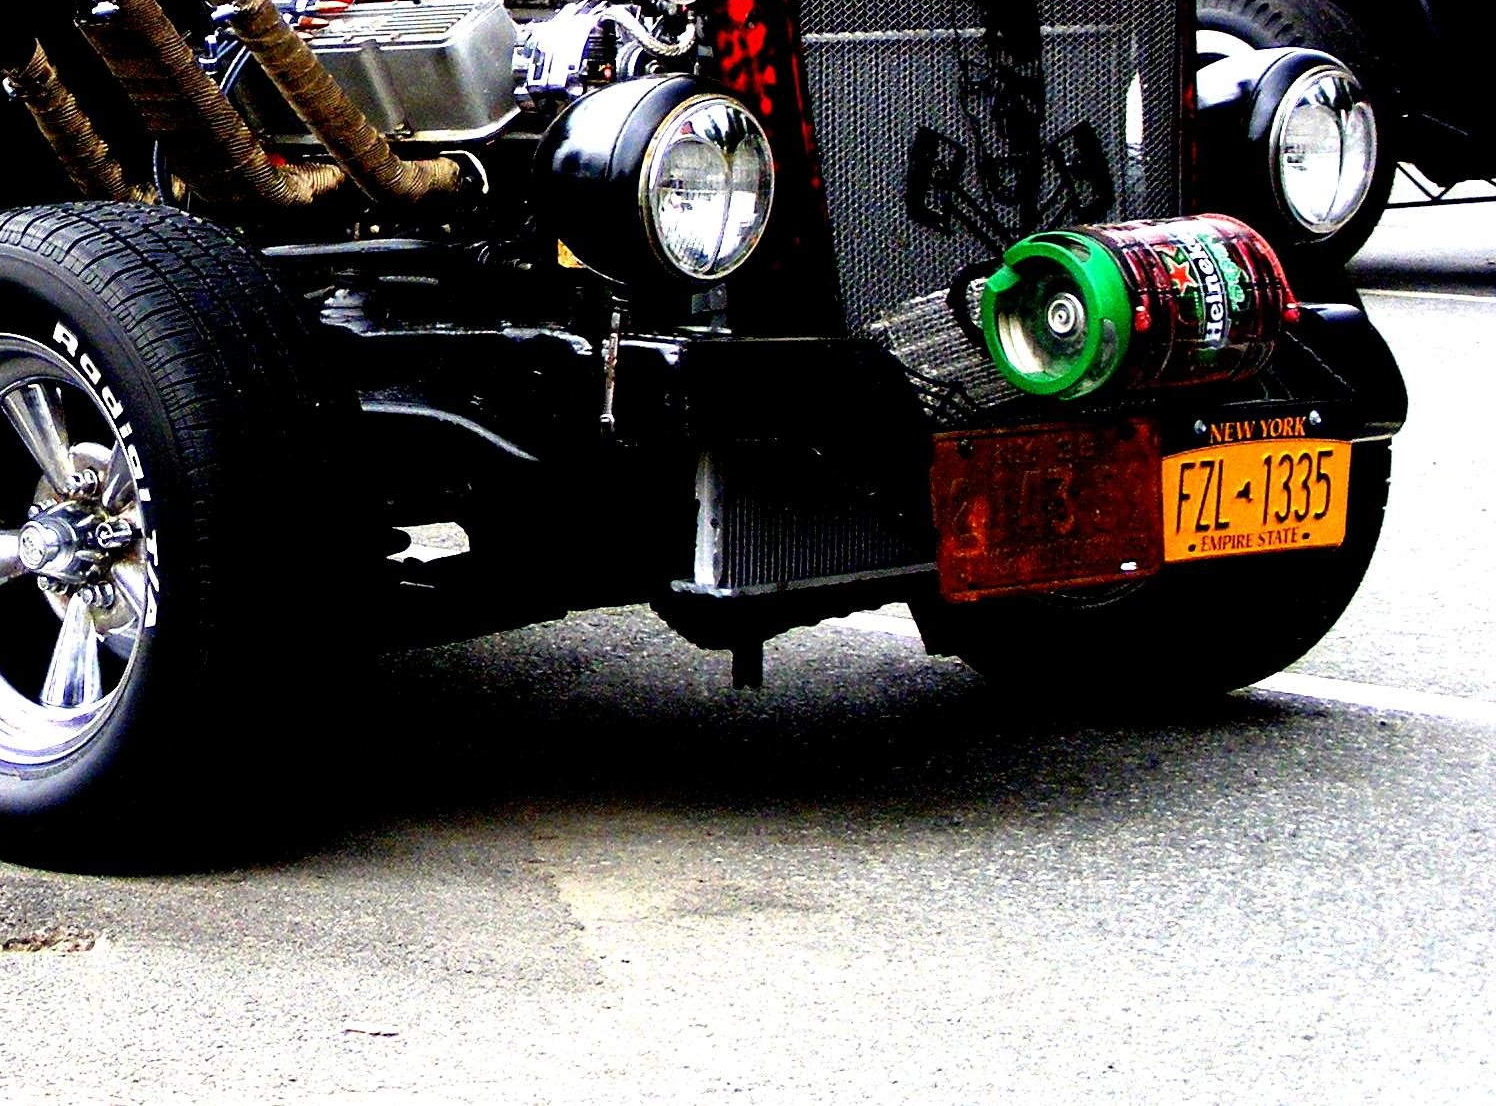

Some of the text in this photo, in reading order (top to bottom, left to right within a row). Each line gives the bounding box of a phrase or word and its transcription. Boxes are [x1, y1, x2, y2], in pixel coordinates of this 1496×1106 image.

[52, 321, 152, 502] Radial
[1210, 416, 1307, 444] NEW YORK
[1201, 527, 1300, 552] EMPIRE STATE
